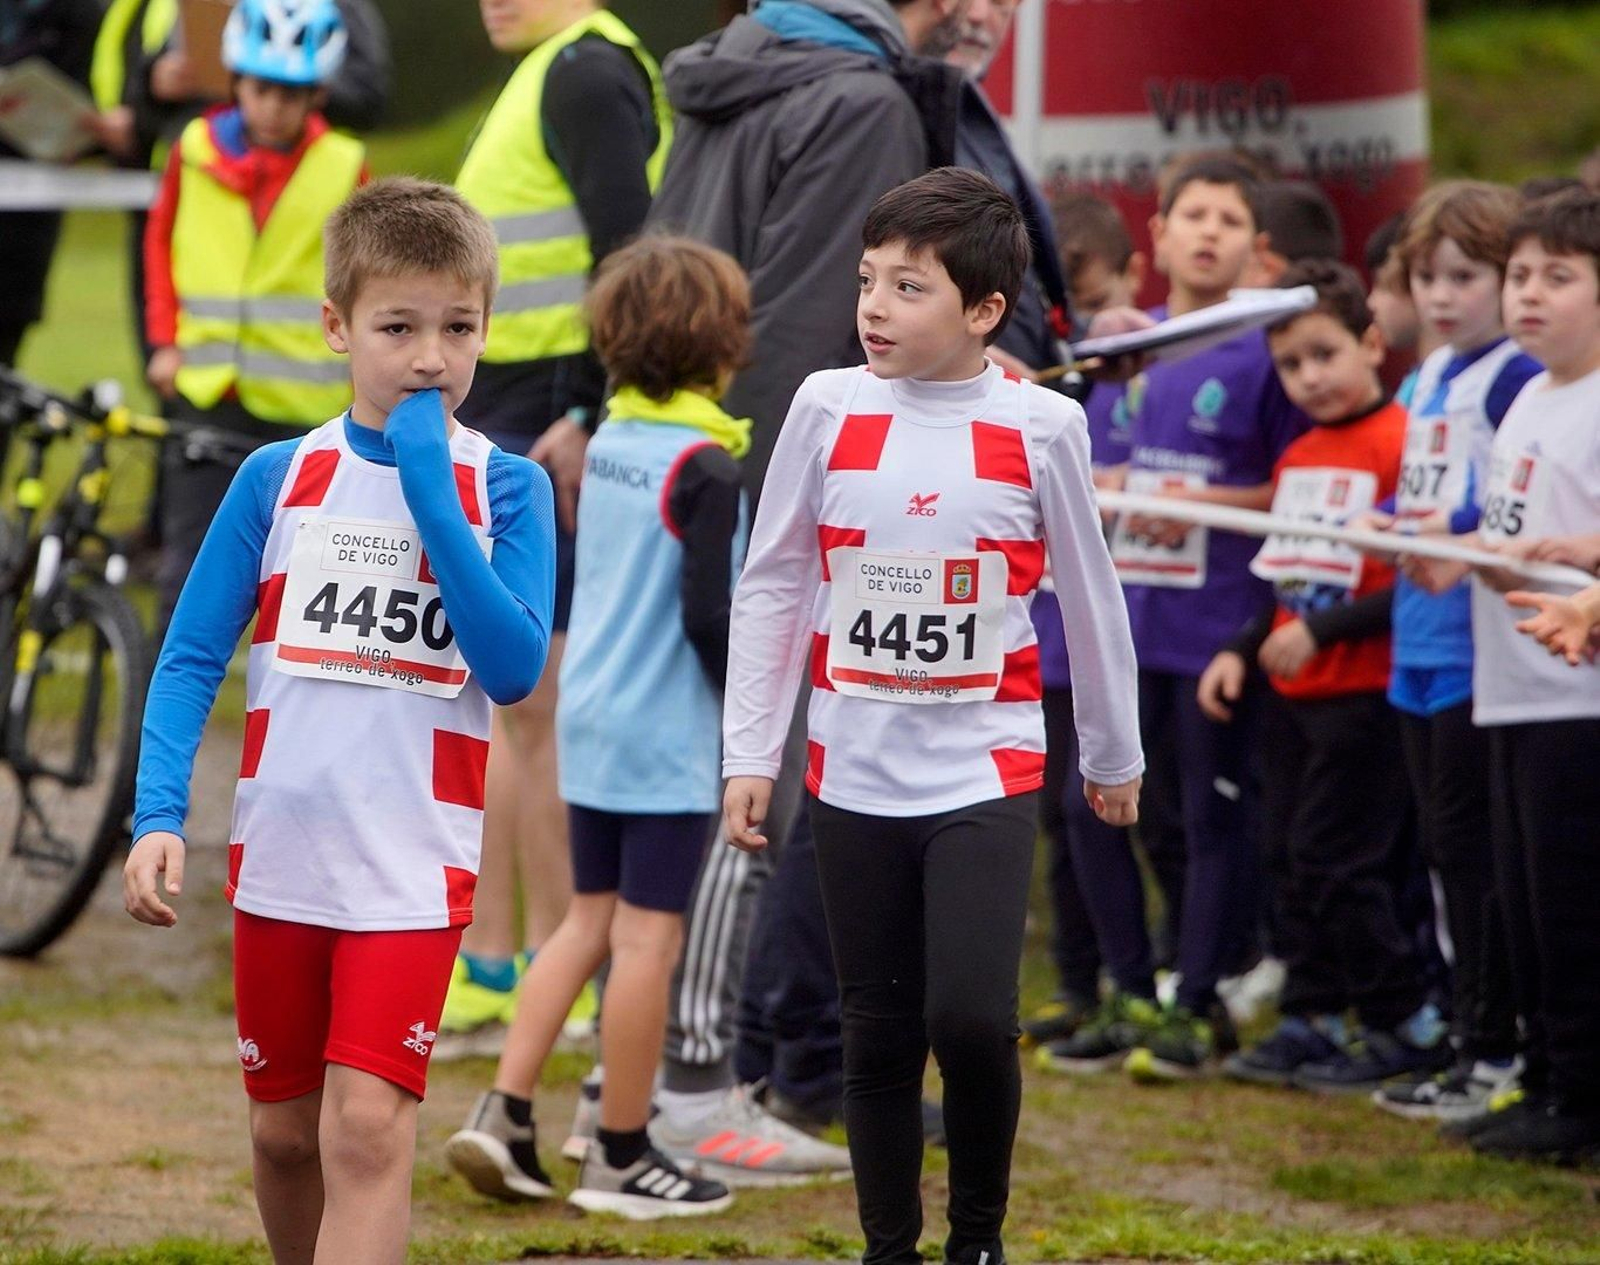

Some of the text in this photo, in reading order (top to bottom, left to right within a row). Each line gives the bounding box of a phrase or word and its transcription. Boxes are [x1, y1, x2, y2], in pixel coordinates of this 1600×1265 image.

[332, 533, 410, 552] CONCELLO
[338, 549, 398, 566] DE VIGO
[861, 563, 932, 580] CONCELLO
[868, 579, 923, 594] DE VIGO
[303, 582, 454, 651] 4450
[849, 609, 977, 663] 4451
[320, 657, 424, 686] terreo de xogo
[869, 678, 960, 699] terreo de xogo
